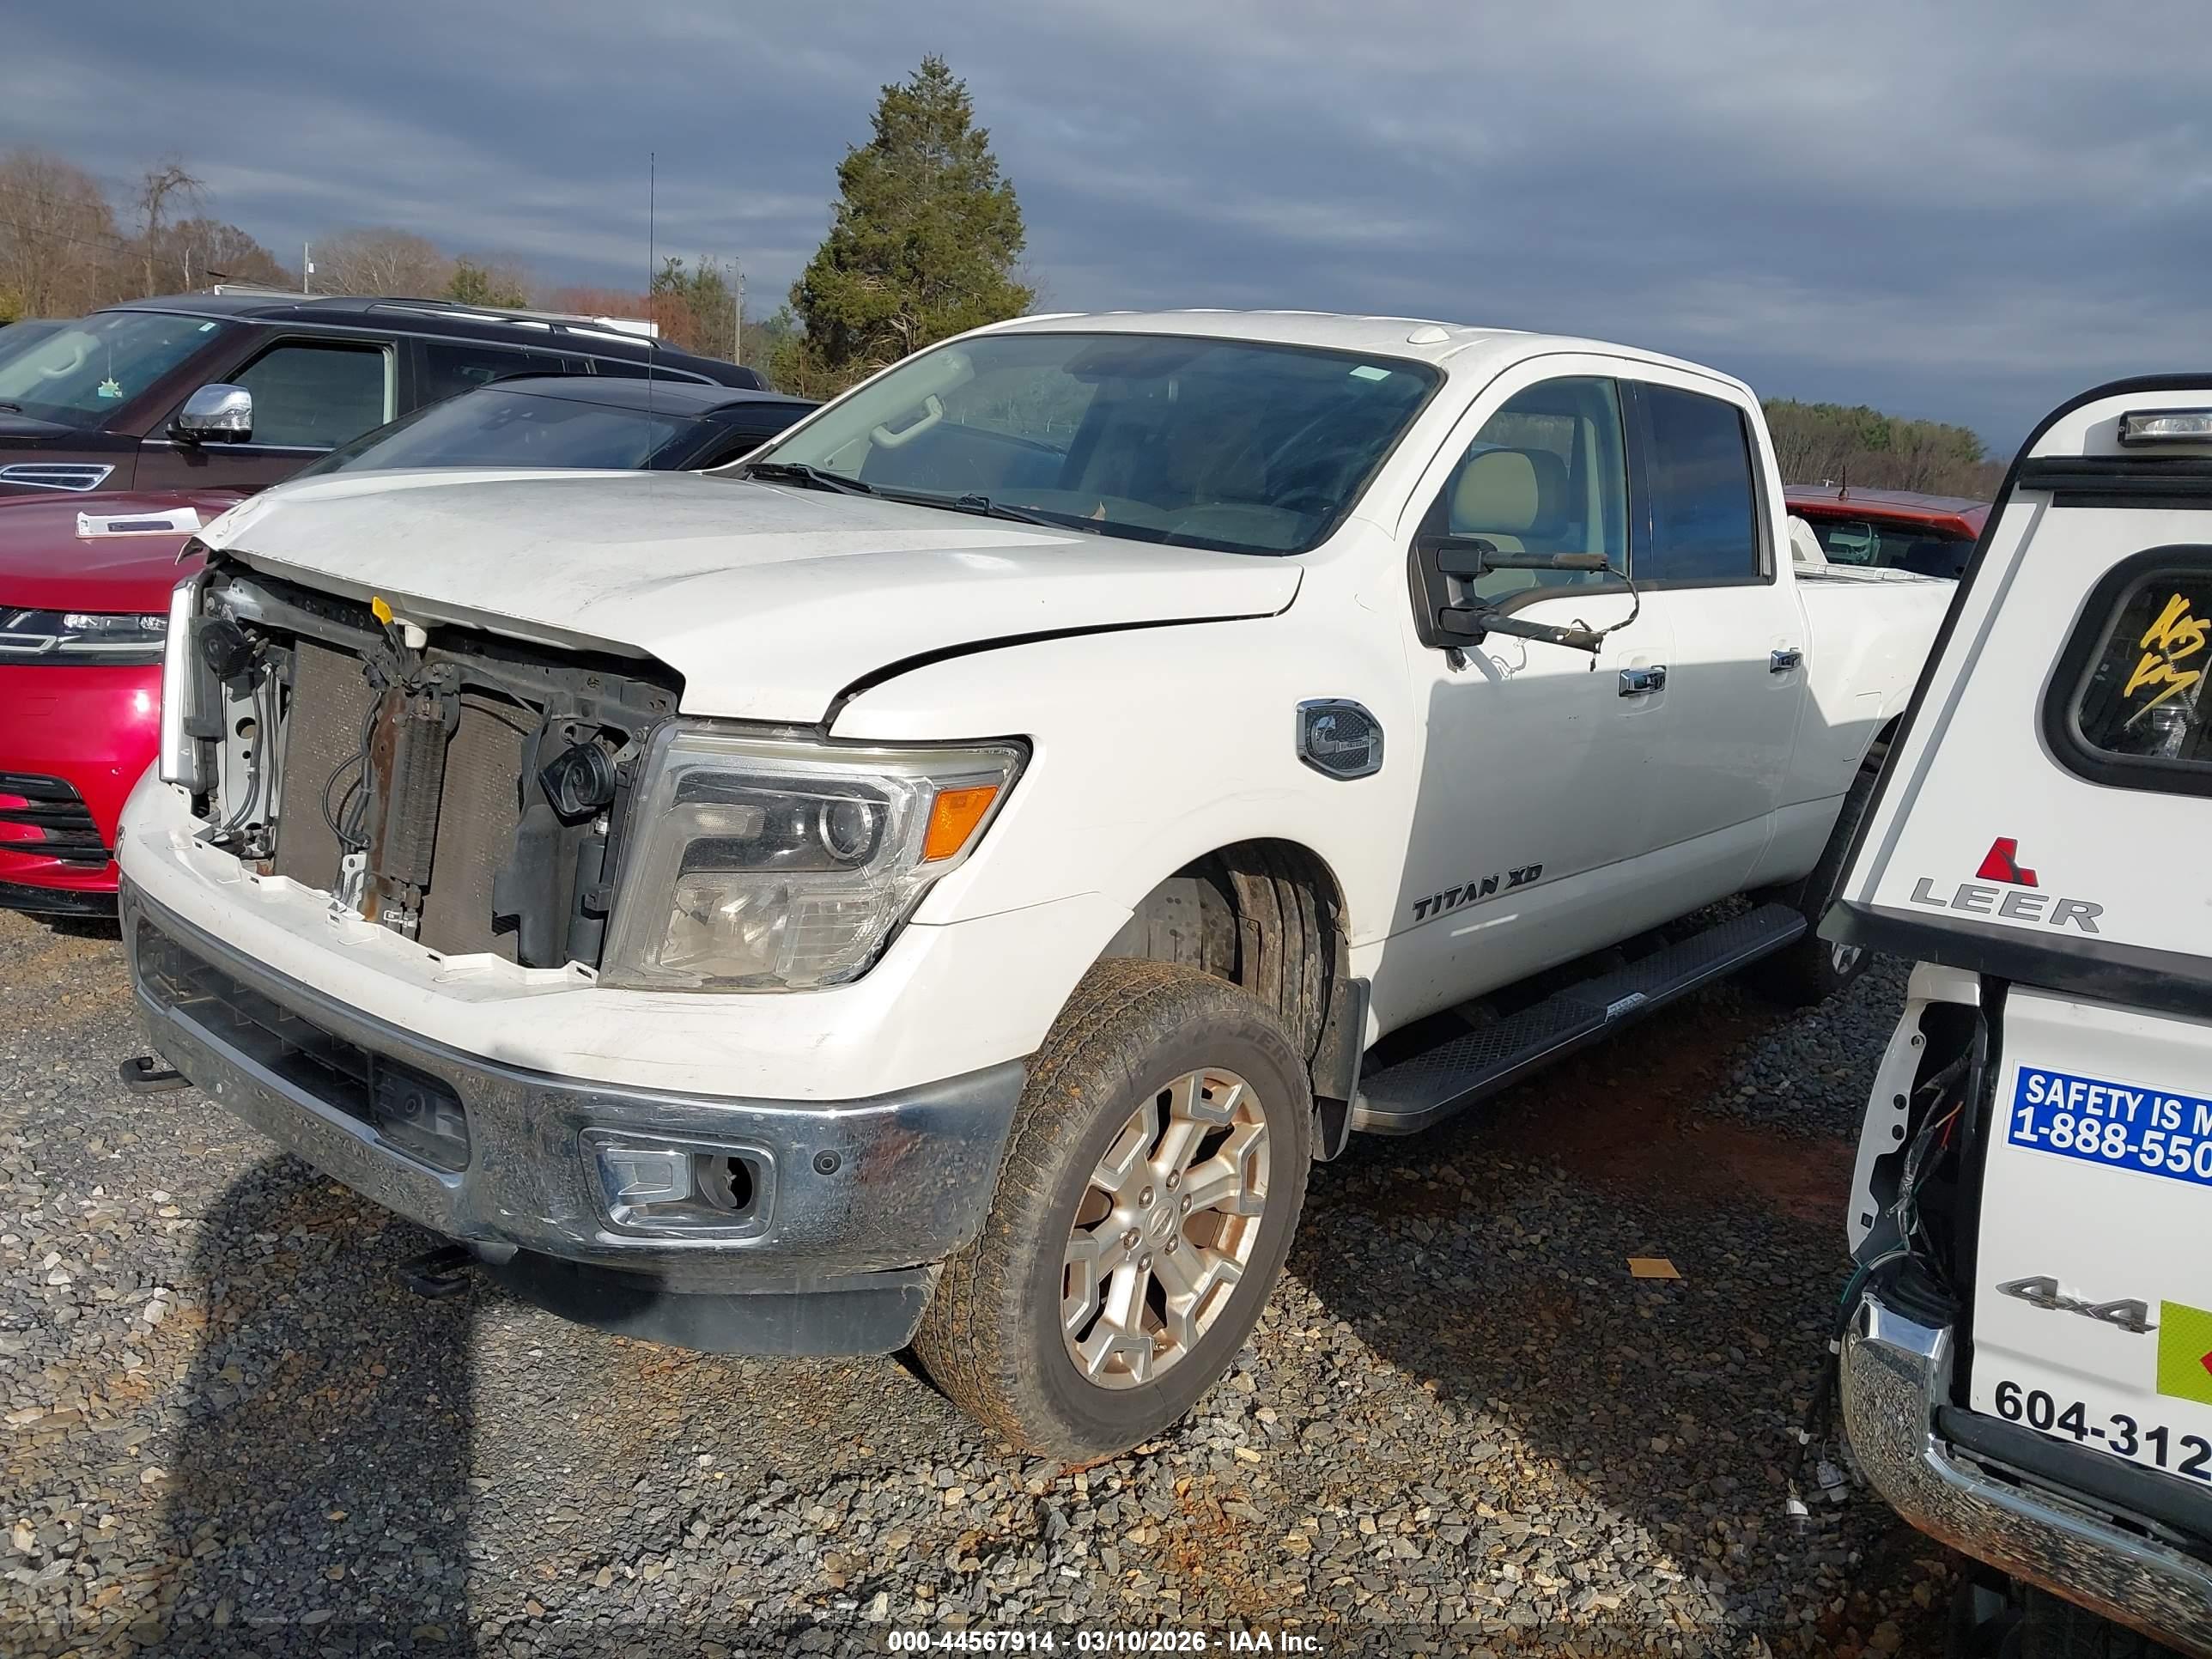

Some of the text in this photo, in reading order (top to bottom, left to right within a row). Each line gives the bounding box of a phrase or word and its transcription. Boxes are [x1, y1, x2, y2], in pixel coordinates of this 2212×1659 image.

[1413, 861, 1545, 921] TITAN XD
[1910, 877, 2105, 933] LEER
[2026, 1074, 2144, 1122] SAFETY
[2150, 1097, 2183, 1130] IS
[1995, 1380, 2212, 1482] 604-312
